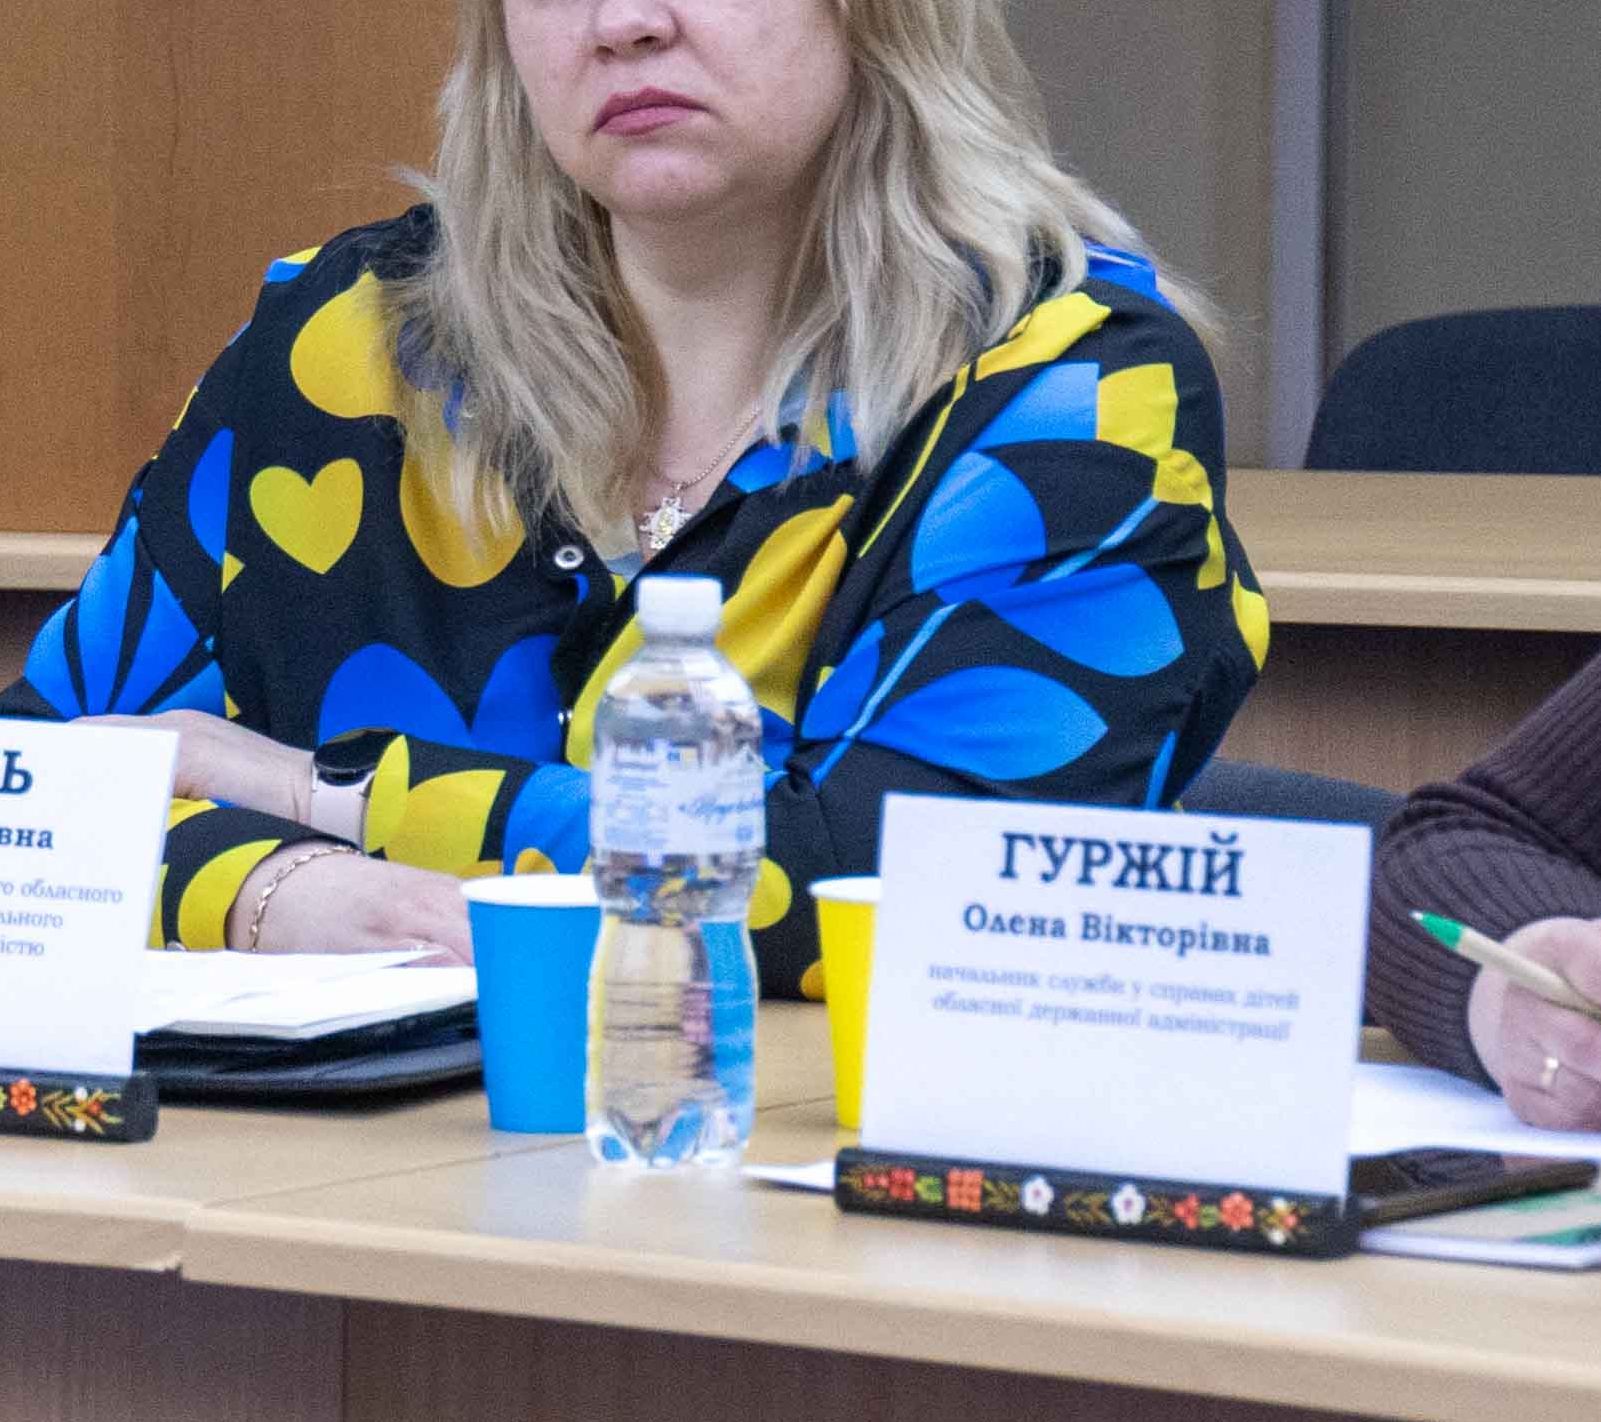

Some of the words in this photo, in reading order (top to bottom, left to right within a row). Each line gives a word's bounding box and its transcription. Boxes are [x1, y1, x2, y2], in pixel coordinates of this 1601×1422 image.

[1000, 831, 1245, 897] ГУРЖІЙ
[20, 879, 123, 904] обласного
[964, 905, 1067, 939] Олена
[1080, 913, 1271, 957] Вікторівна
